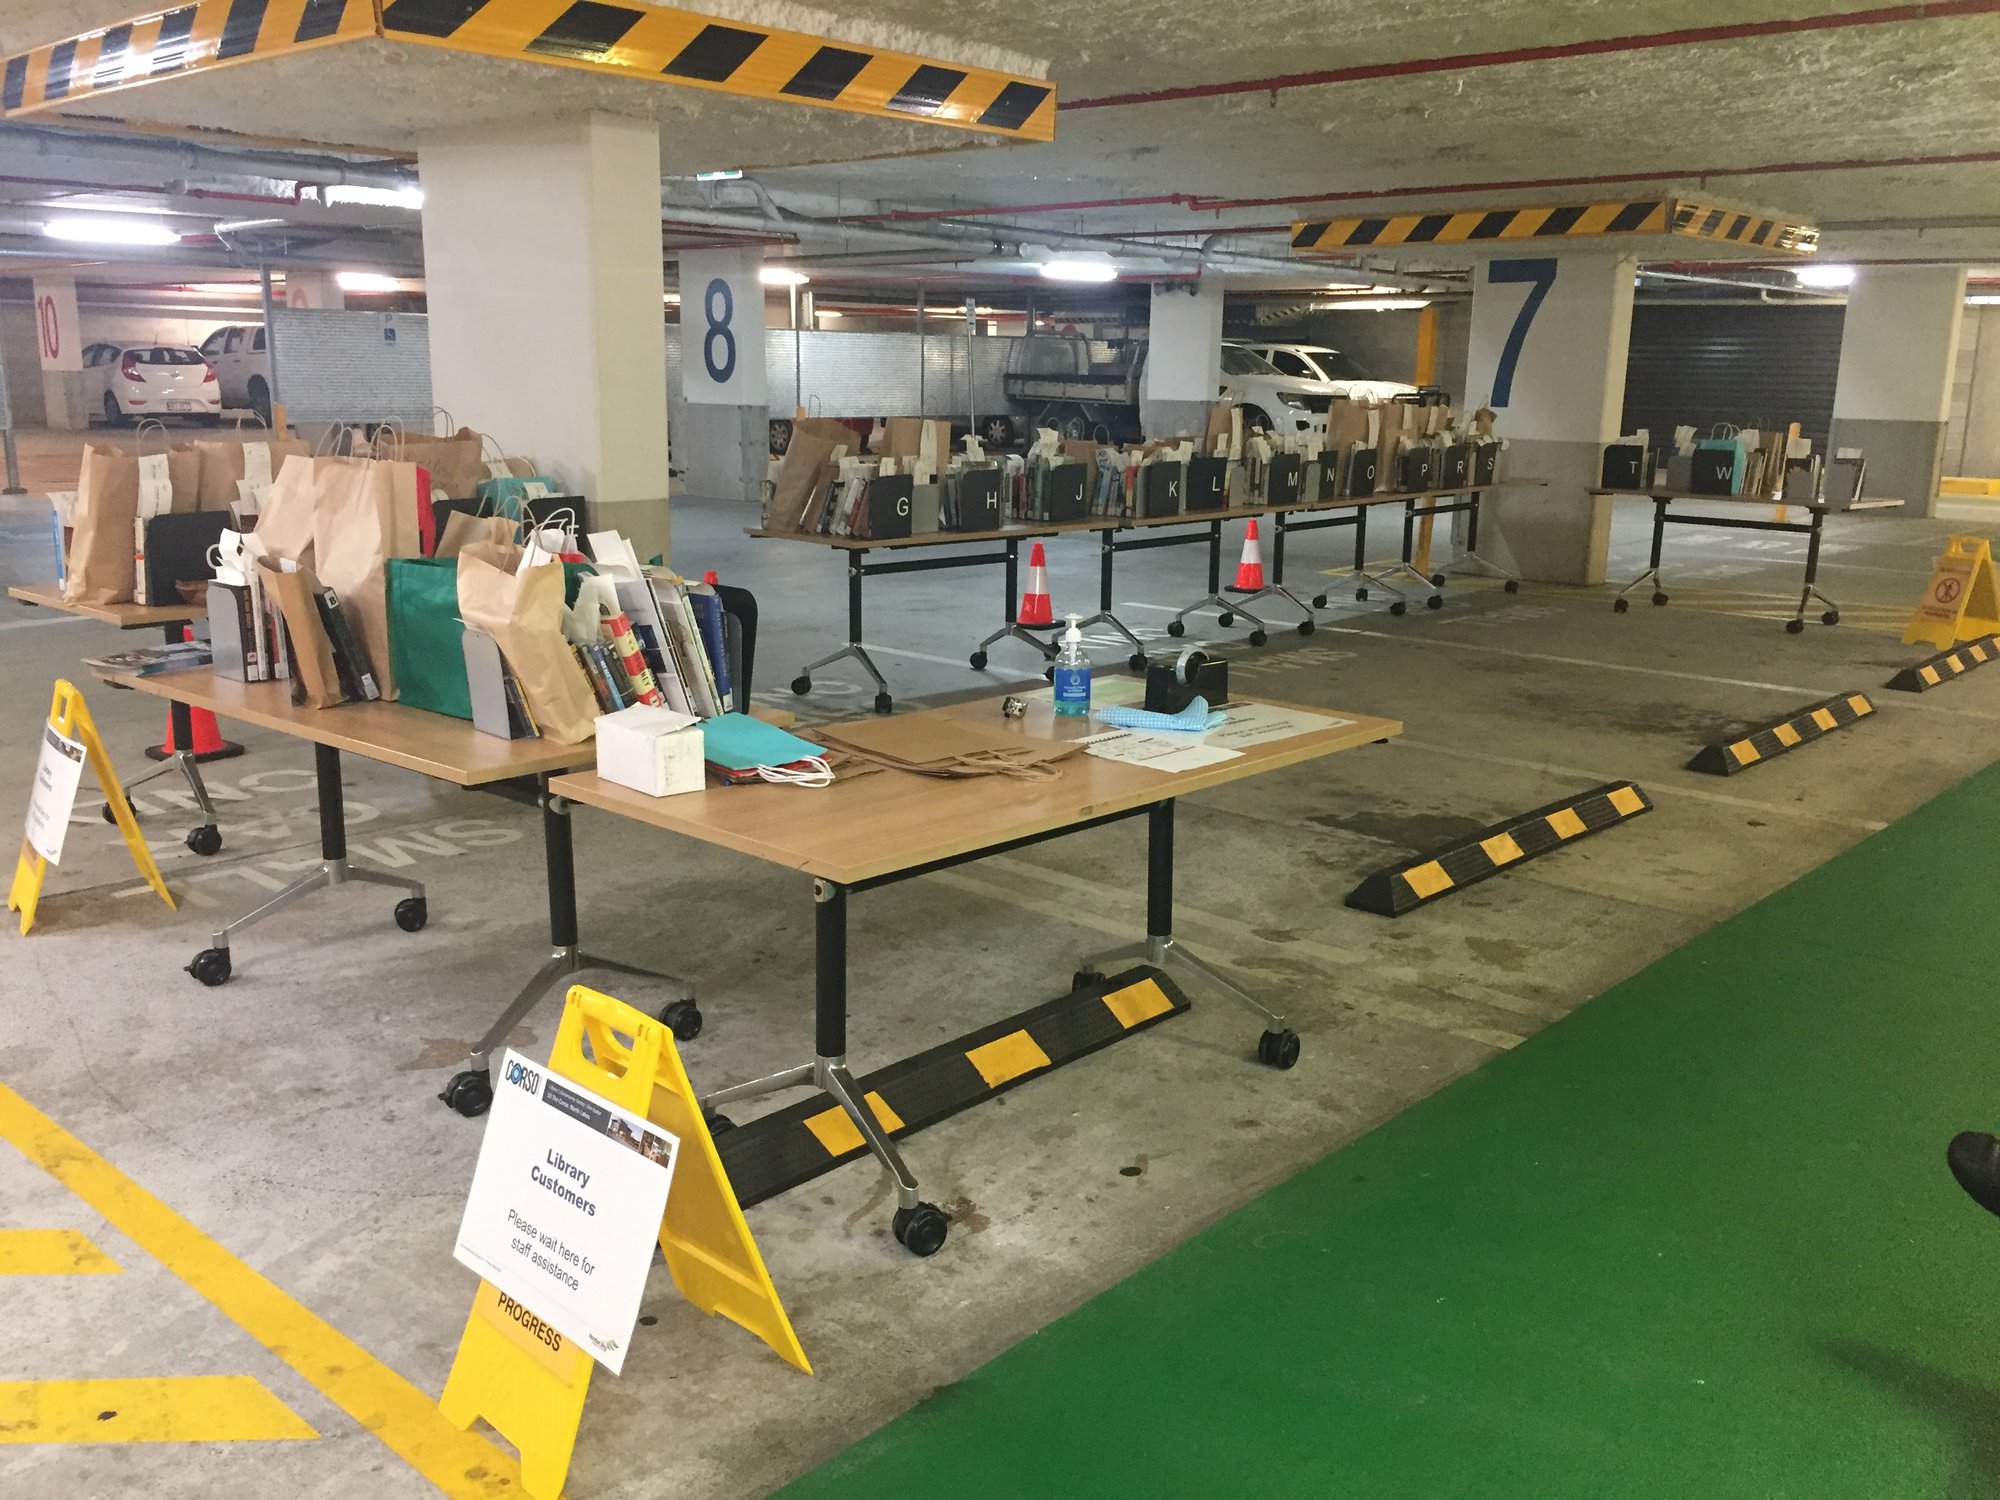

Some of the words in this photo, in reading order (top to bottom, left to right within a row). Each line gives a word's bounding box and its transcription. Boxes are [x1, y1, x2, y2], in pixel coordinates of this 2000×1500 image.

[38, 295, 59, 359] 10
[704, 278, 736, 383] 8
[1488, 258, 1558, 407] 7
[1366, 465, 1375, 480] O
[1421, 463, 1428, 477] P
[1456, 460, 1464, 474] R
[1487, 457, 1494, 470] S
[1629, 461, 1639, 475] T
[1287, 471, 1298, 487] M
[1326, 467, 1335, 482] N
[1716, 466, 1733, 480] W
[1075, 483, 1083, 501] J
[1168, 480, 1178, 498] K
[1212, 476, 1221, 492] L
[896, 497, 909, 516] G
[986, 491, 997, 510] H
[505, 1059, 540, 1095] CORSO
[546, 1148, 591, 1189] Library
[530, 1165, 597, 1217] Customers
[507, 1208, 538, 1239] Please
[538, 1232, 558, 1253] wait
[558, 1241, 580, 1267] here
[580, 1256, 596, 1276] for
[511, 1238, 533, 1258] staff
[530, 1251, 580, 1291] assistance
[497, 1290, 562, 1352] PROGRESS
